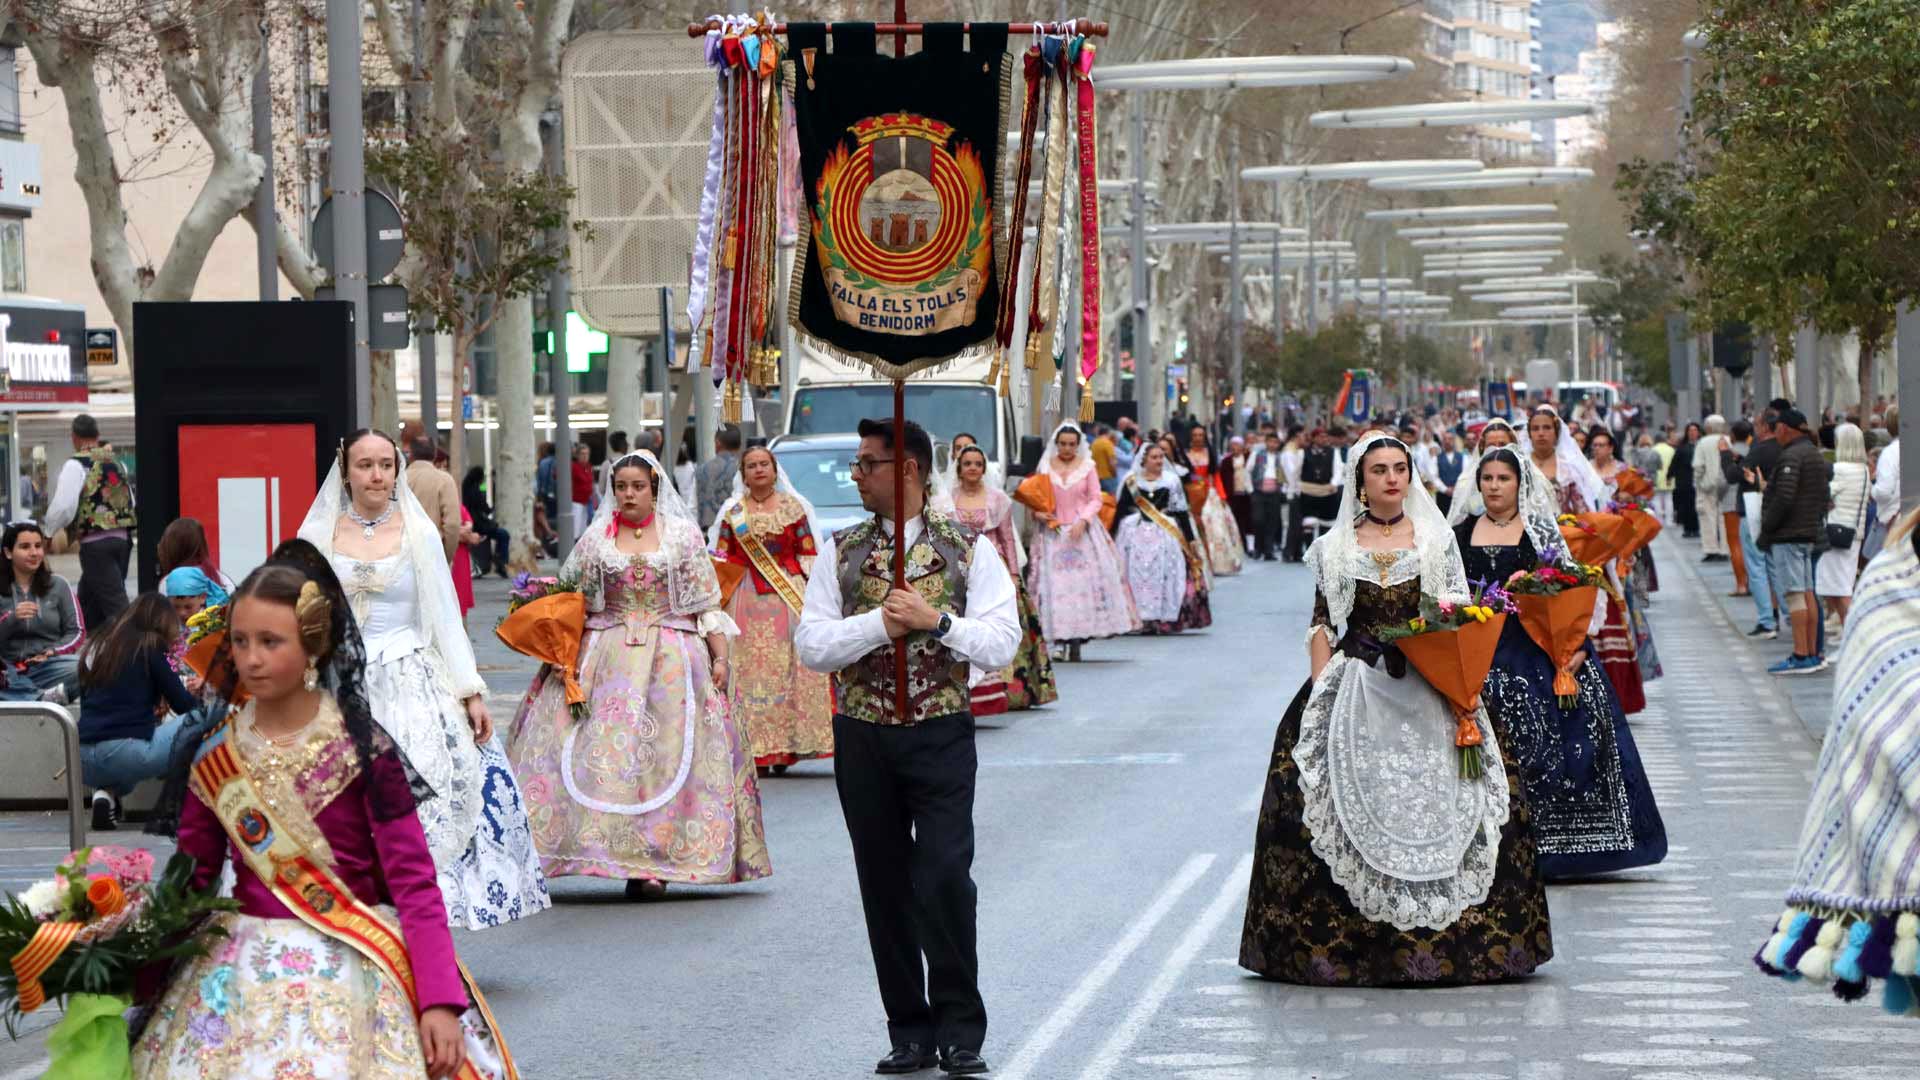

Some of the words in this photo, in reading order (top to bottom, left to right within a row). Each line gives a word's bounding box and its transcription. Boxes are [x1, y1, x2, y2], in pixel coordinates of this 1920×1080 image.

[832, 281, 877, 311] FALLA
[882, 298, 912, 313] ELS
[916, 287, 967, 311] TOLLS
[859, 312, 936, 330] BENIDORM
[88, 351, 113, 362] ATM
